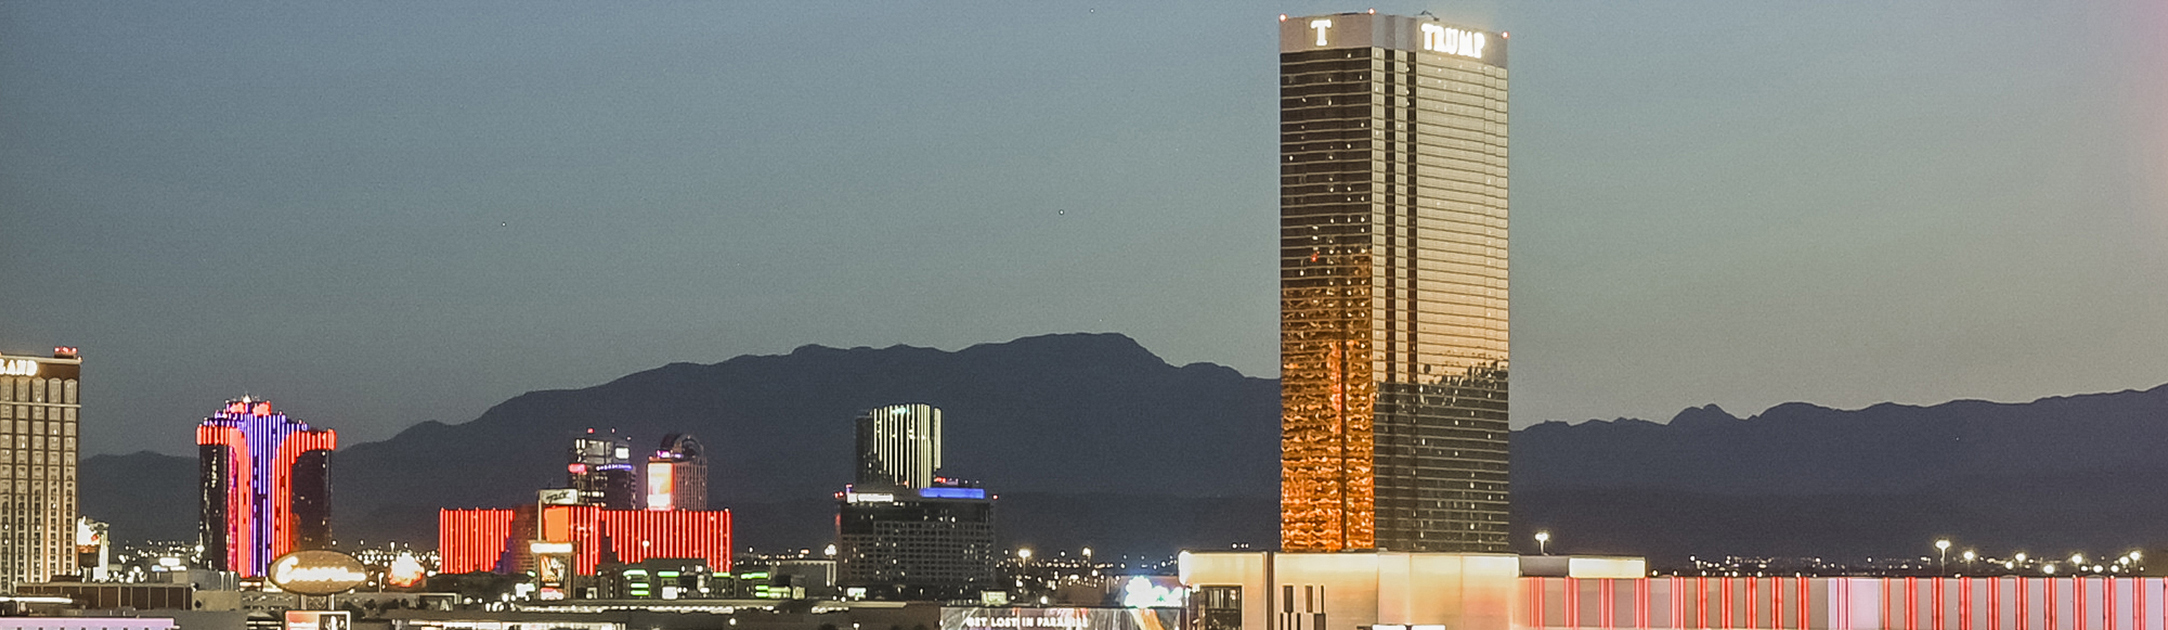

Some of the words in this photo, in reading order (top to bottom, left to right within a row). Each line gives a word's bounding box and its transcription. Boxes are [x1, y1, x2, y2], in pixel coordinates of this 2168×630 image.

[1310, 19, 1332, 46] T
[1421, 23, 1486, 59] TRUMP
[991, 617, 1018, 627] LOST
[1022, 617, 1034, 627] IN
